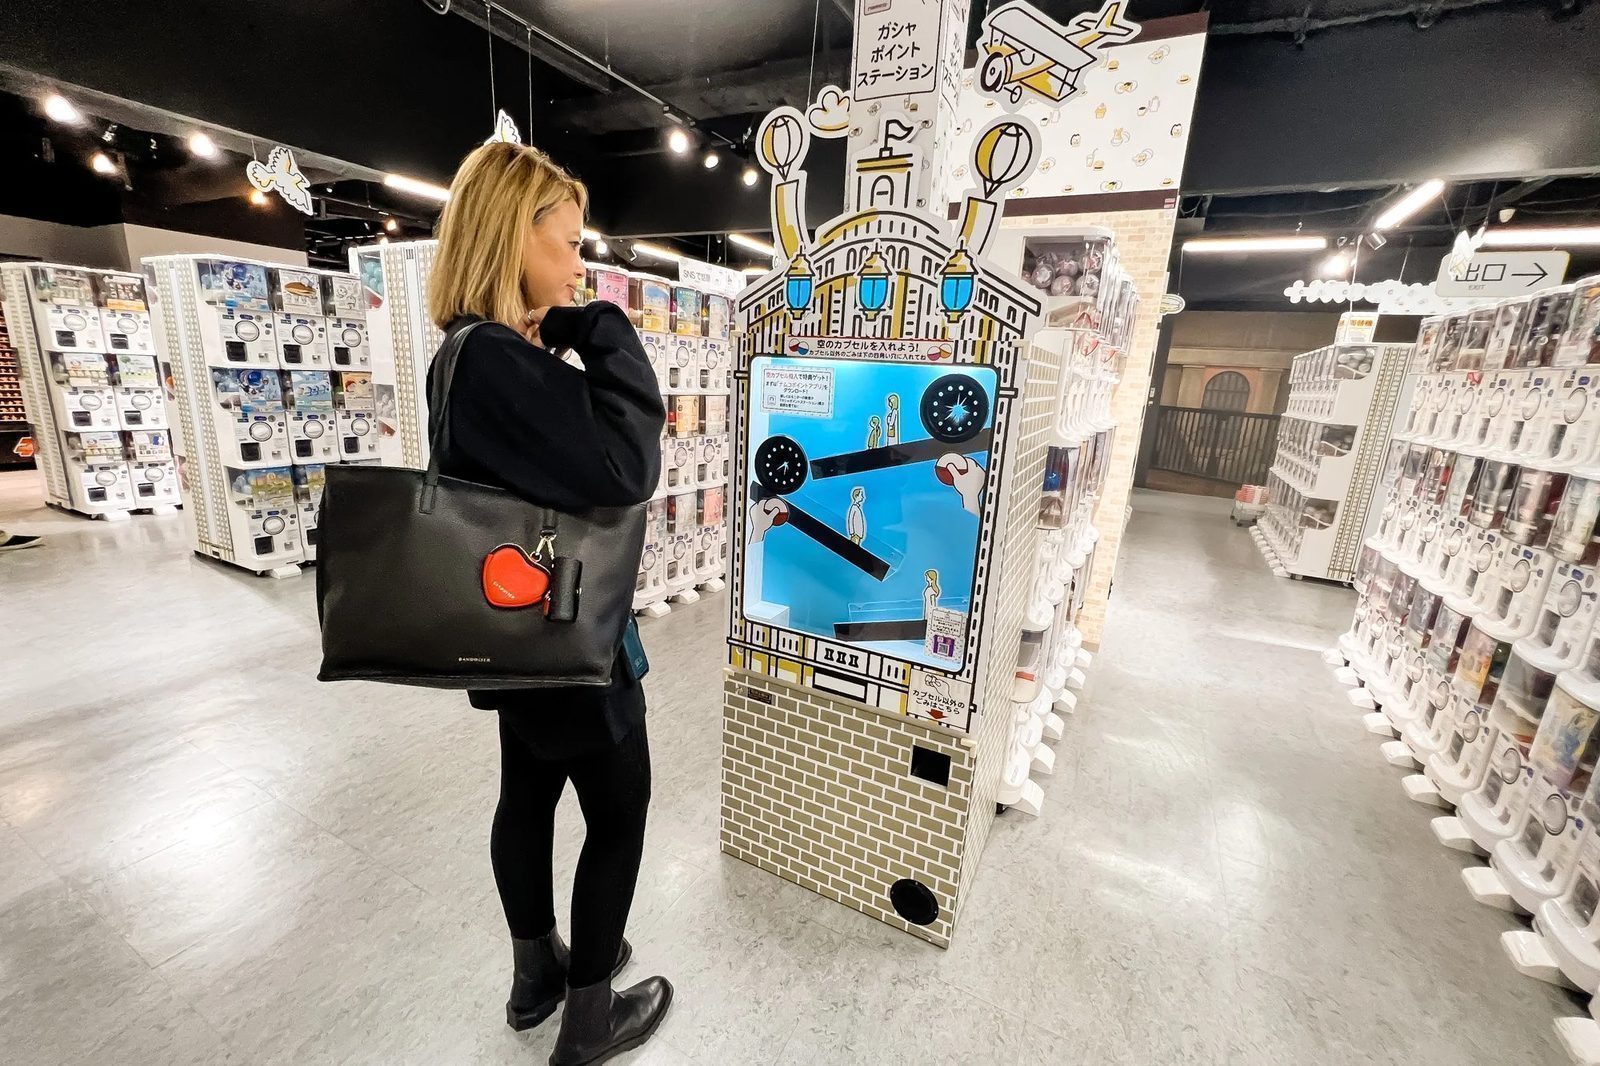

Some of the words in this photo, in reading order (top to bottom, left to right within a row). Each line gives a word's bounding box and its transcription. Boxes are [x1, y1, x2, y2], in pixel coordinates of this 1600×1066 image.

[877, 21, 917, 41] ガシャ
[870, 41, 920, 63] ポイント
[857, 63, 934, 88] ステーション
[1454, 262, 1507, 282] 出口
[817, 339, 919, 353] 空のカプセルを入れよう!
[912, 690, 965, 709] カプセル以外の
[915, 697, 960, 715] ごみはこちら
